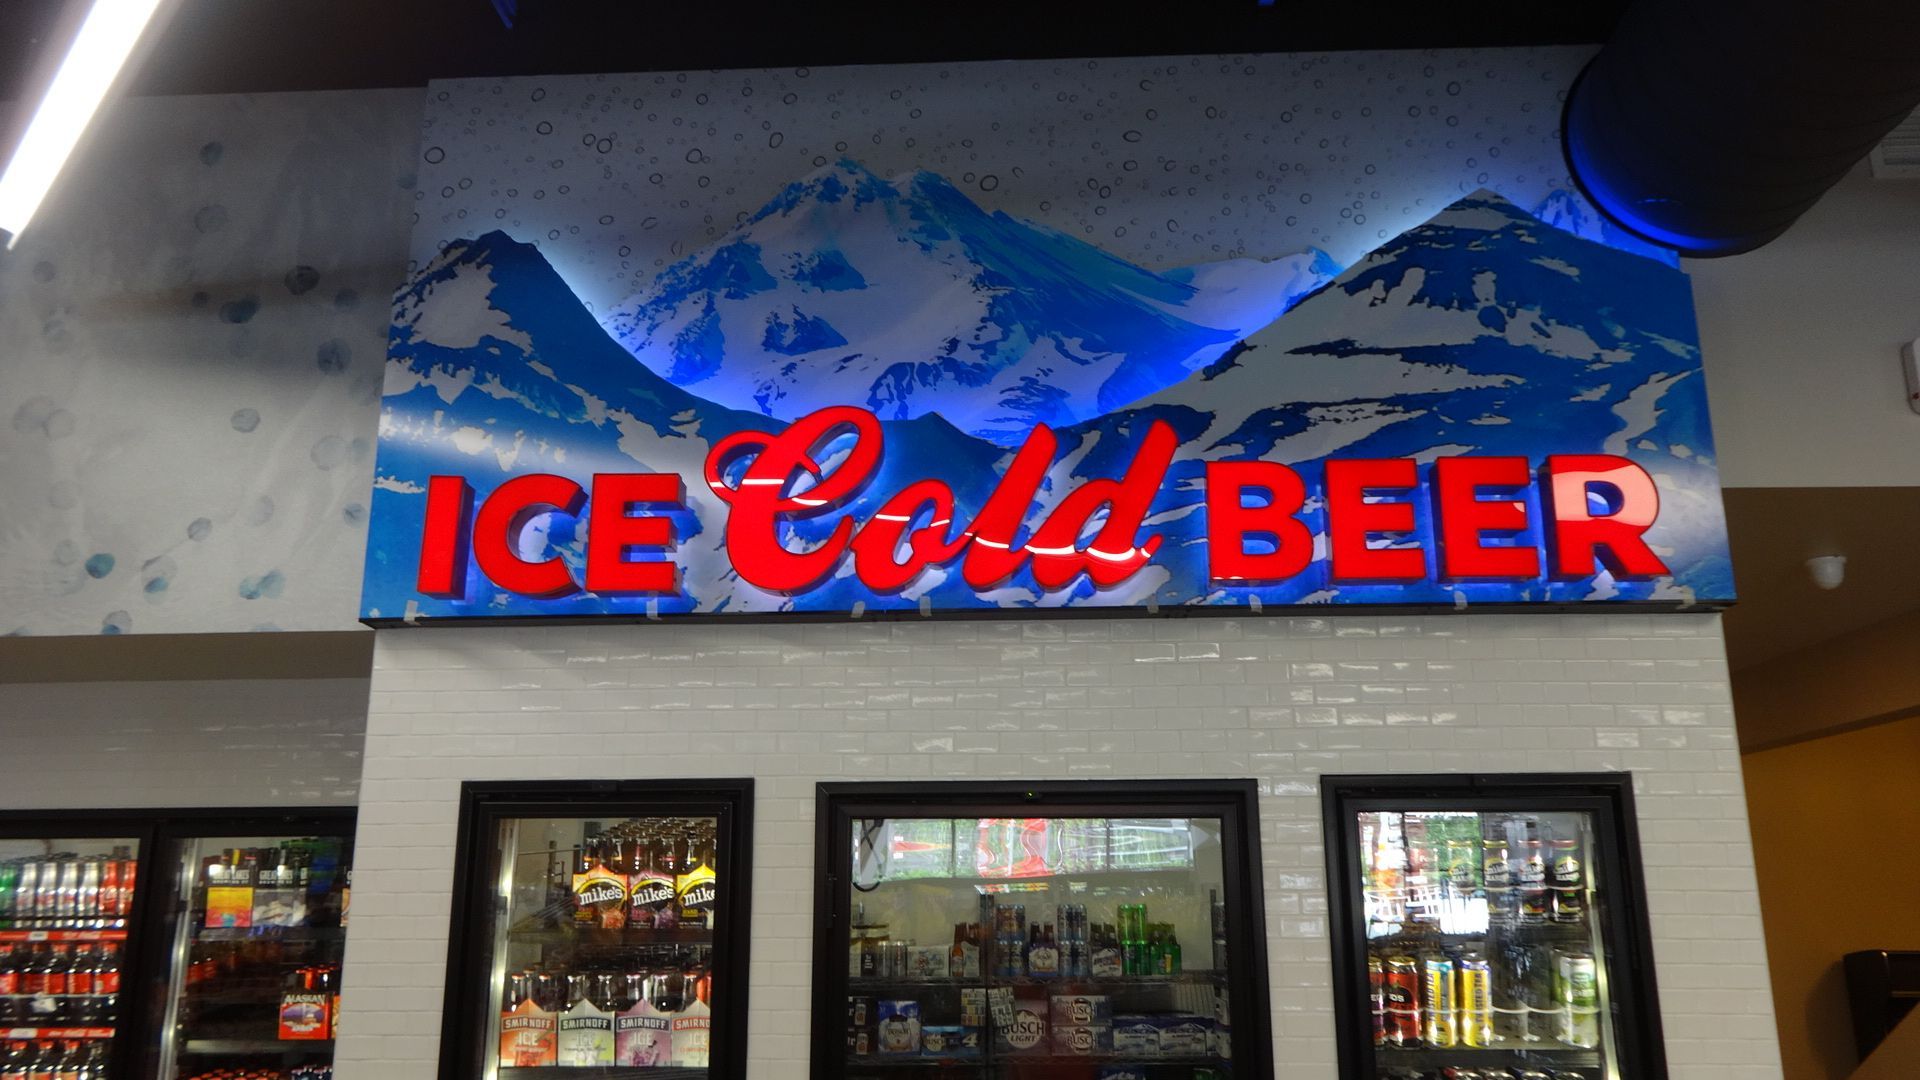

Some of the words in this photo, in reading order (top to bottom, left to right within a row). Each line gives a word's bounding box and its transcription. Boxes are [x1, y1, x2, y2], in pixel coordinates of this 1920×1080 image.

[418, 472, 685, 596] ICE
[704, 405, 1180, 595] Cold
[1204, 455, 1672, 583] BEER
[579, 886, 624, 906] mike's
[632, 886, 675, 907] mike's
[283, 993, 326, 1006] ALASKAN
[505, 1018, 552, 1030] SMIRNOFF
[562, 1018, 608, 1030] SMIRNOFF
[620, 1018, 667, 1030] SMIRNOFF
[1001, 1021, 1045, 1035] BUSCH
[517, 1033, 538, 1045] ICE
[576, 1033, 594, 1045] ICE
[632, 1033, 652, 1045] ICE
[688, 1033, 706, 1045] ICE
[1010, 1034, 1036, 1042] LIGHT
